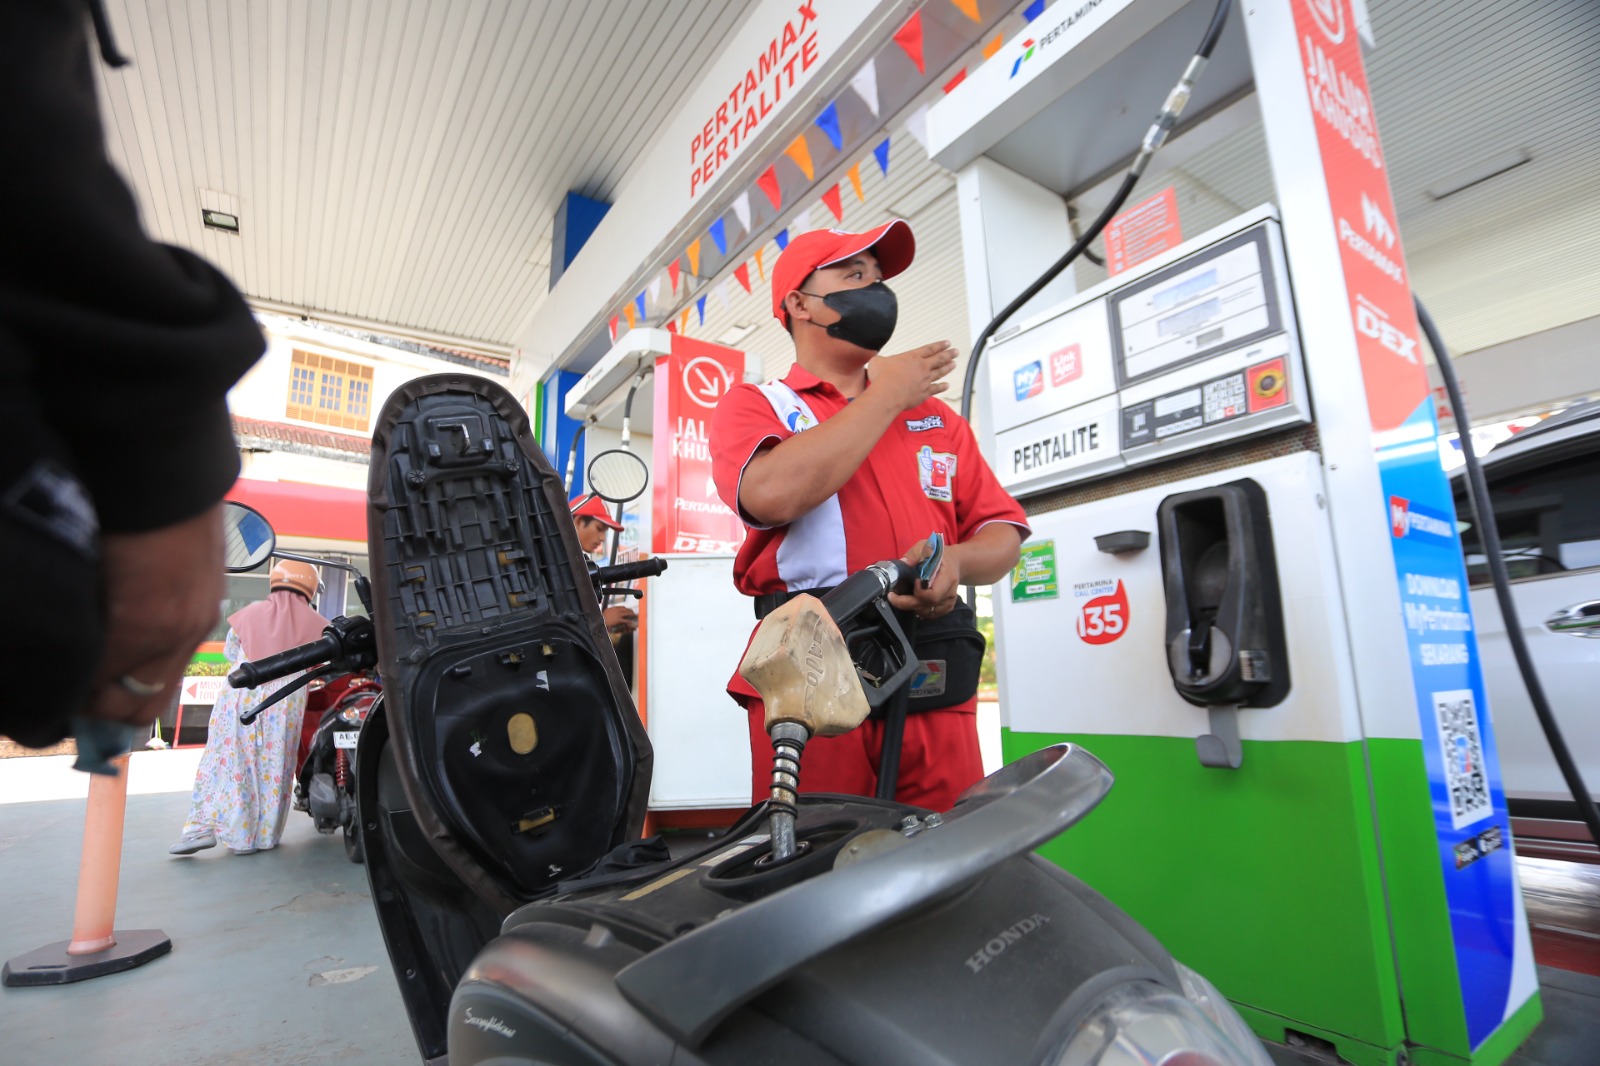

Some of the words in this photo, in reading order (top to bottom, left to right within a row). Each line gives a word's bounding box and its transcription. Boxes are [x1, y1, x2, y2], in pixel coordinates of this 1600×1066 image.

[1040, 0, 1104, 49] PERTAMIN
[691, 0, 818, 165] PERTAMAX
[691, 29, 819, 198] PERTALITE
[1357, 304, 1418, 365] DEX
[674, 416, 709, 443] JAL
[1014, 422, 1099, 475] PERTALITE
[673, 537, 738, 554] DEX
[1080, 603, 1124, 638] 135
[965, 913, 1051, 974] HONDA
